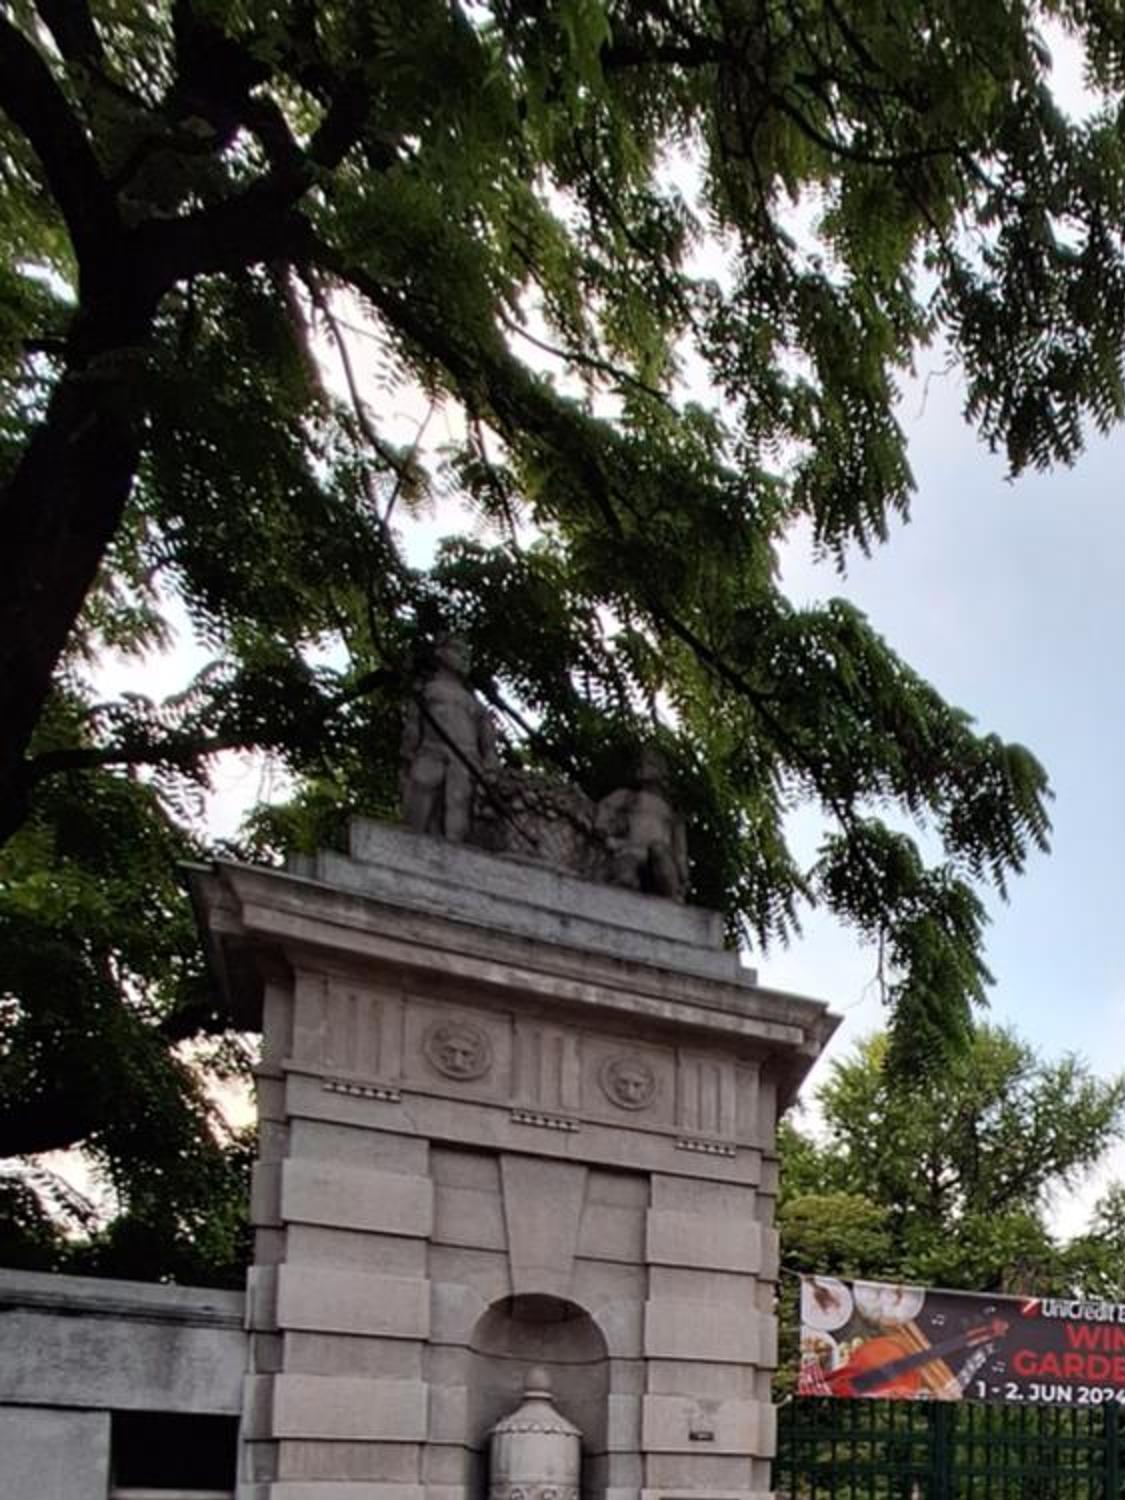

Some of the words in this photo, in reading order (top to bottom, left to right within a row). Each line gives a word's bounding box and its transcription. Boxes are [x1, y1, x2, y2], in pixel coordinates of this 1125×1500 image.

[1041, 1299, 1115, 1322] UniCredit
[976, 1380, 986, 1399] 1
[1005, 1382, 1024, 1400] 2.
[1028, 1383, 1073, 1402] JUN
